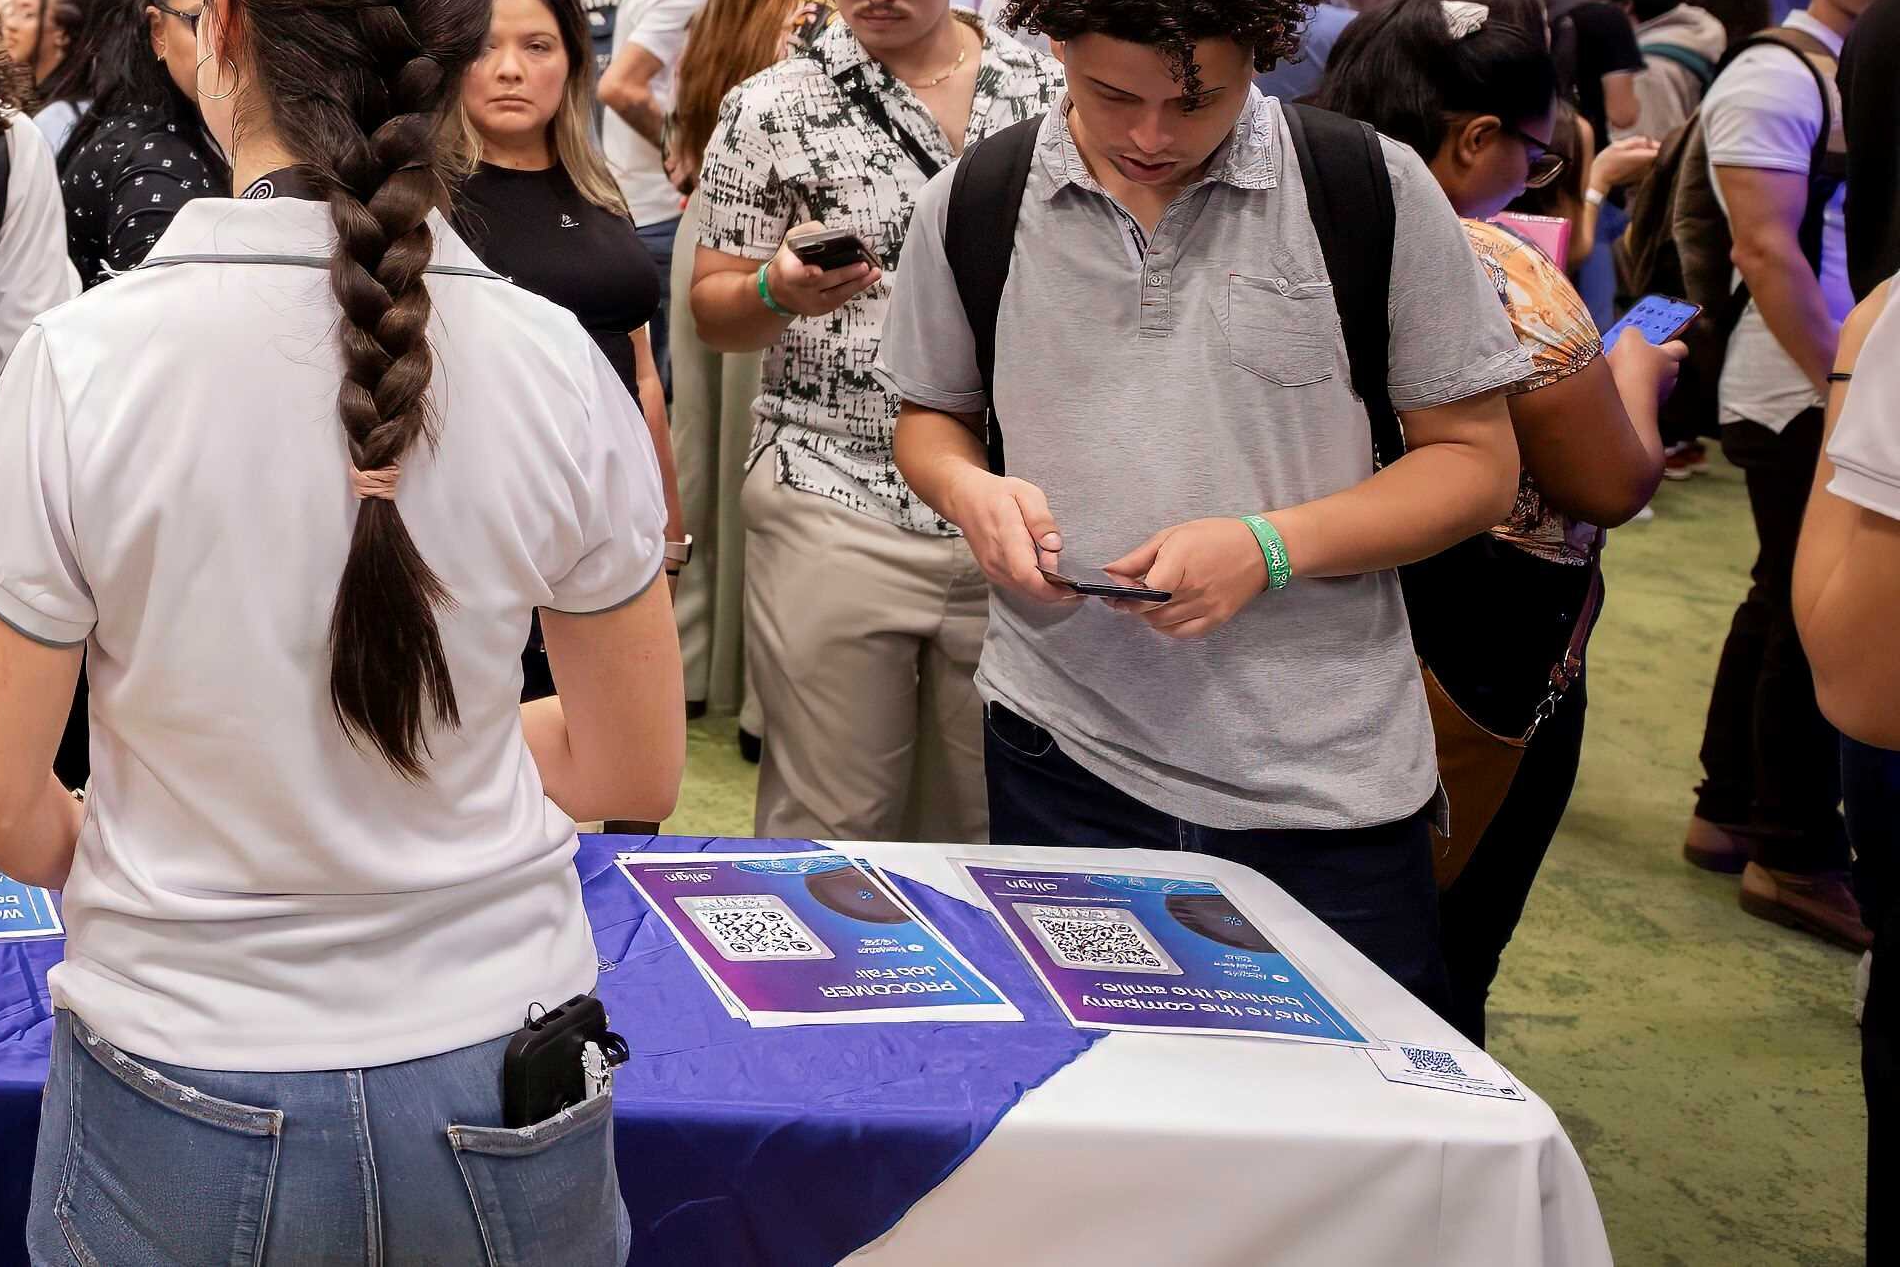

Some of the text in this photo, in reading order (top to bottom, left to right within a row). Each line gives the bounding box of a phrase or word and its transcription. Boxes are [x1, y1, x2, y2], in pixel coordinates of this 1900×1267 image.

[664, 871, 712, 883] align
[1005, 879, 1058, 892] align
[856, 965, 937, 981] Job Fair
[818, 980, 958, 998] PROCOMER
[1095, 982, 1304, 1009] behind the smile.
[1082, 994, 1321, 1026] We're the company
